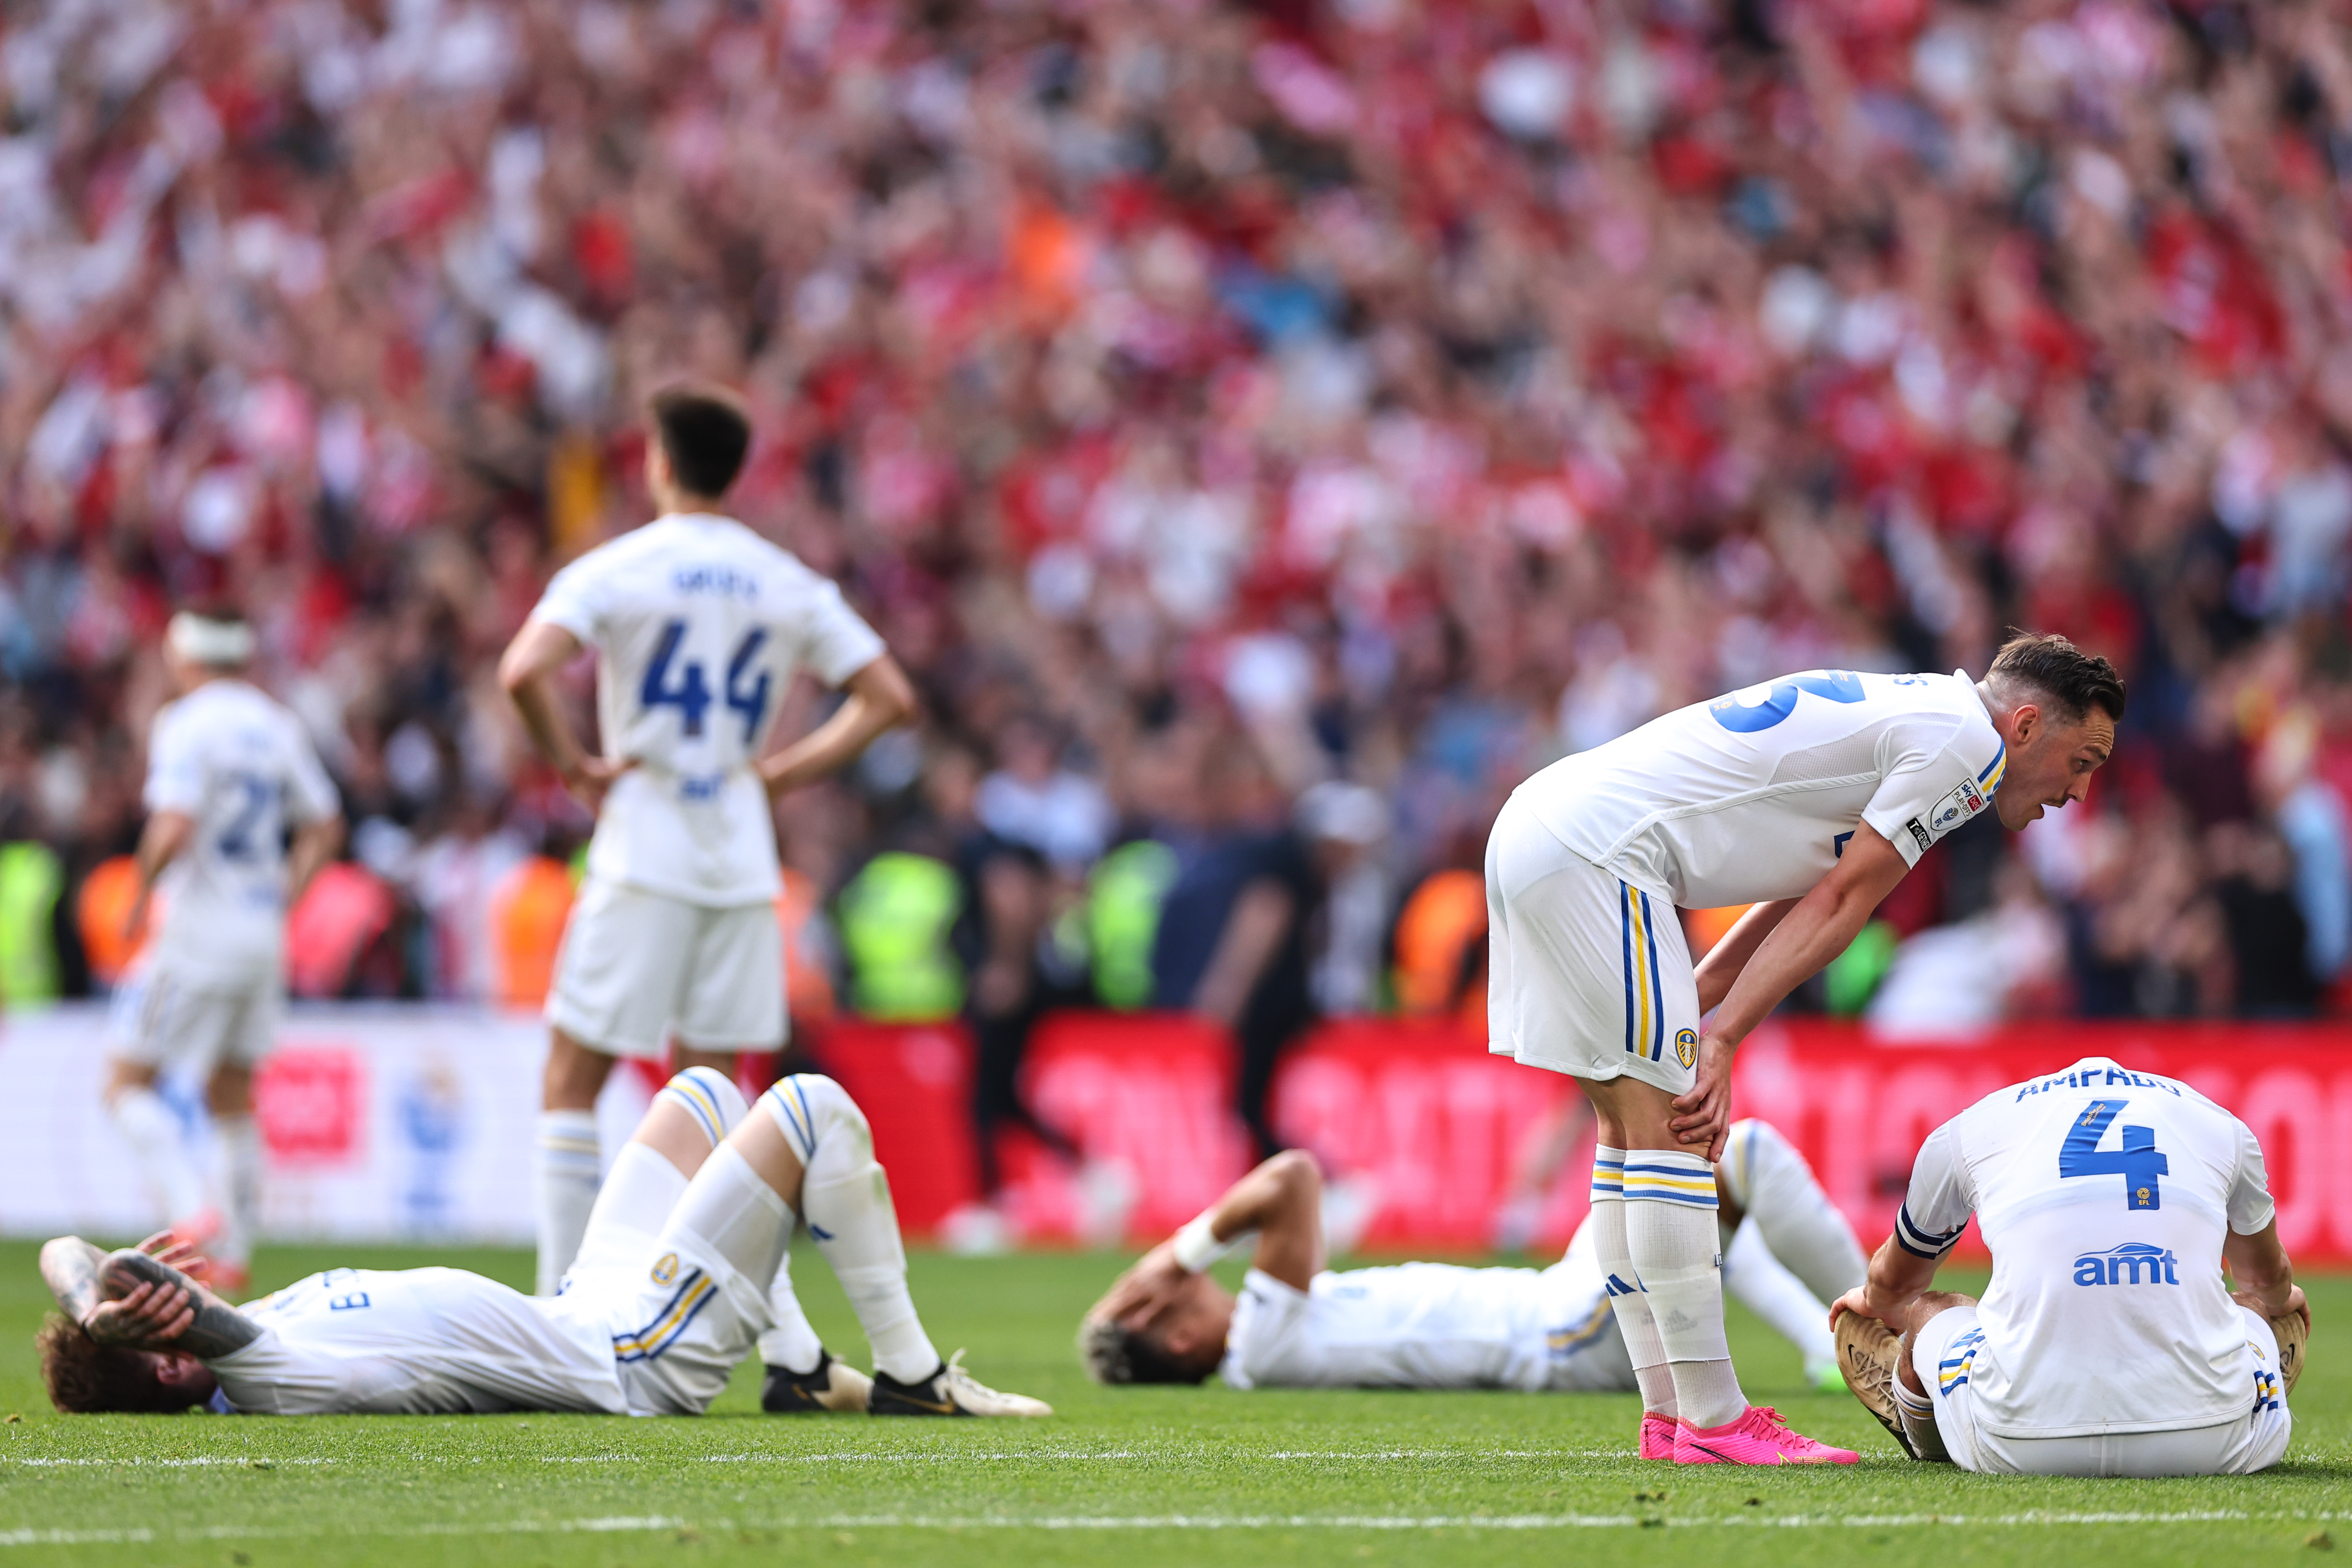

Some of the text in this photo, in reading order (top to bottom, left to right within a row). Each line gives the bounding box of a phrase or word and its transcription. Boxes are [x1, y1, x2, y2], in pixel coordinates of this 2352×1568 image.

[640, 618, 773, 747] 44
[1954, 791, 1972, 817] PLAY-OFFS
[1961, 784, 1980, 810] sky bet
[1935, 817, 1943, 828] EFL
[2059, 1100, 2169, 1210] 4
[2073, 1250, 2180, 1287] amt
